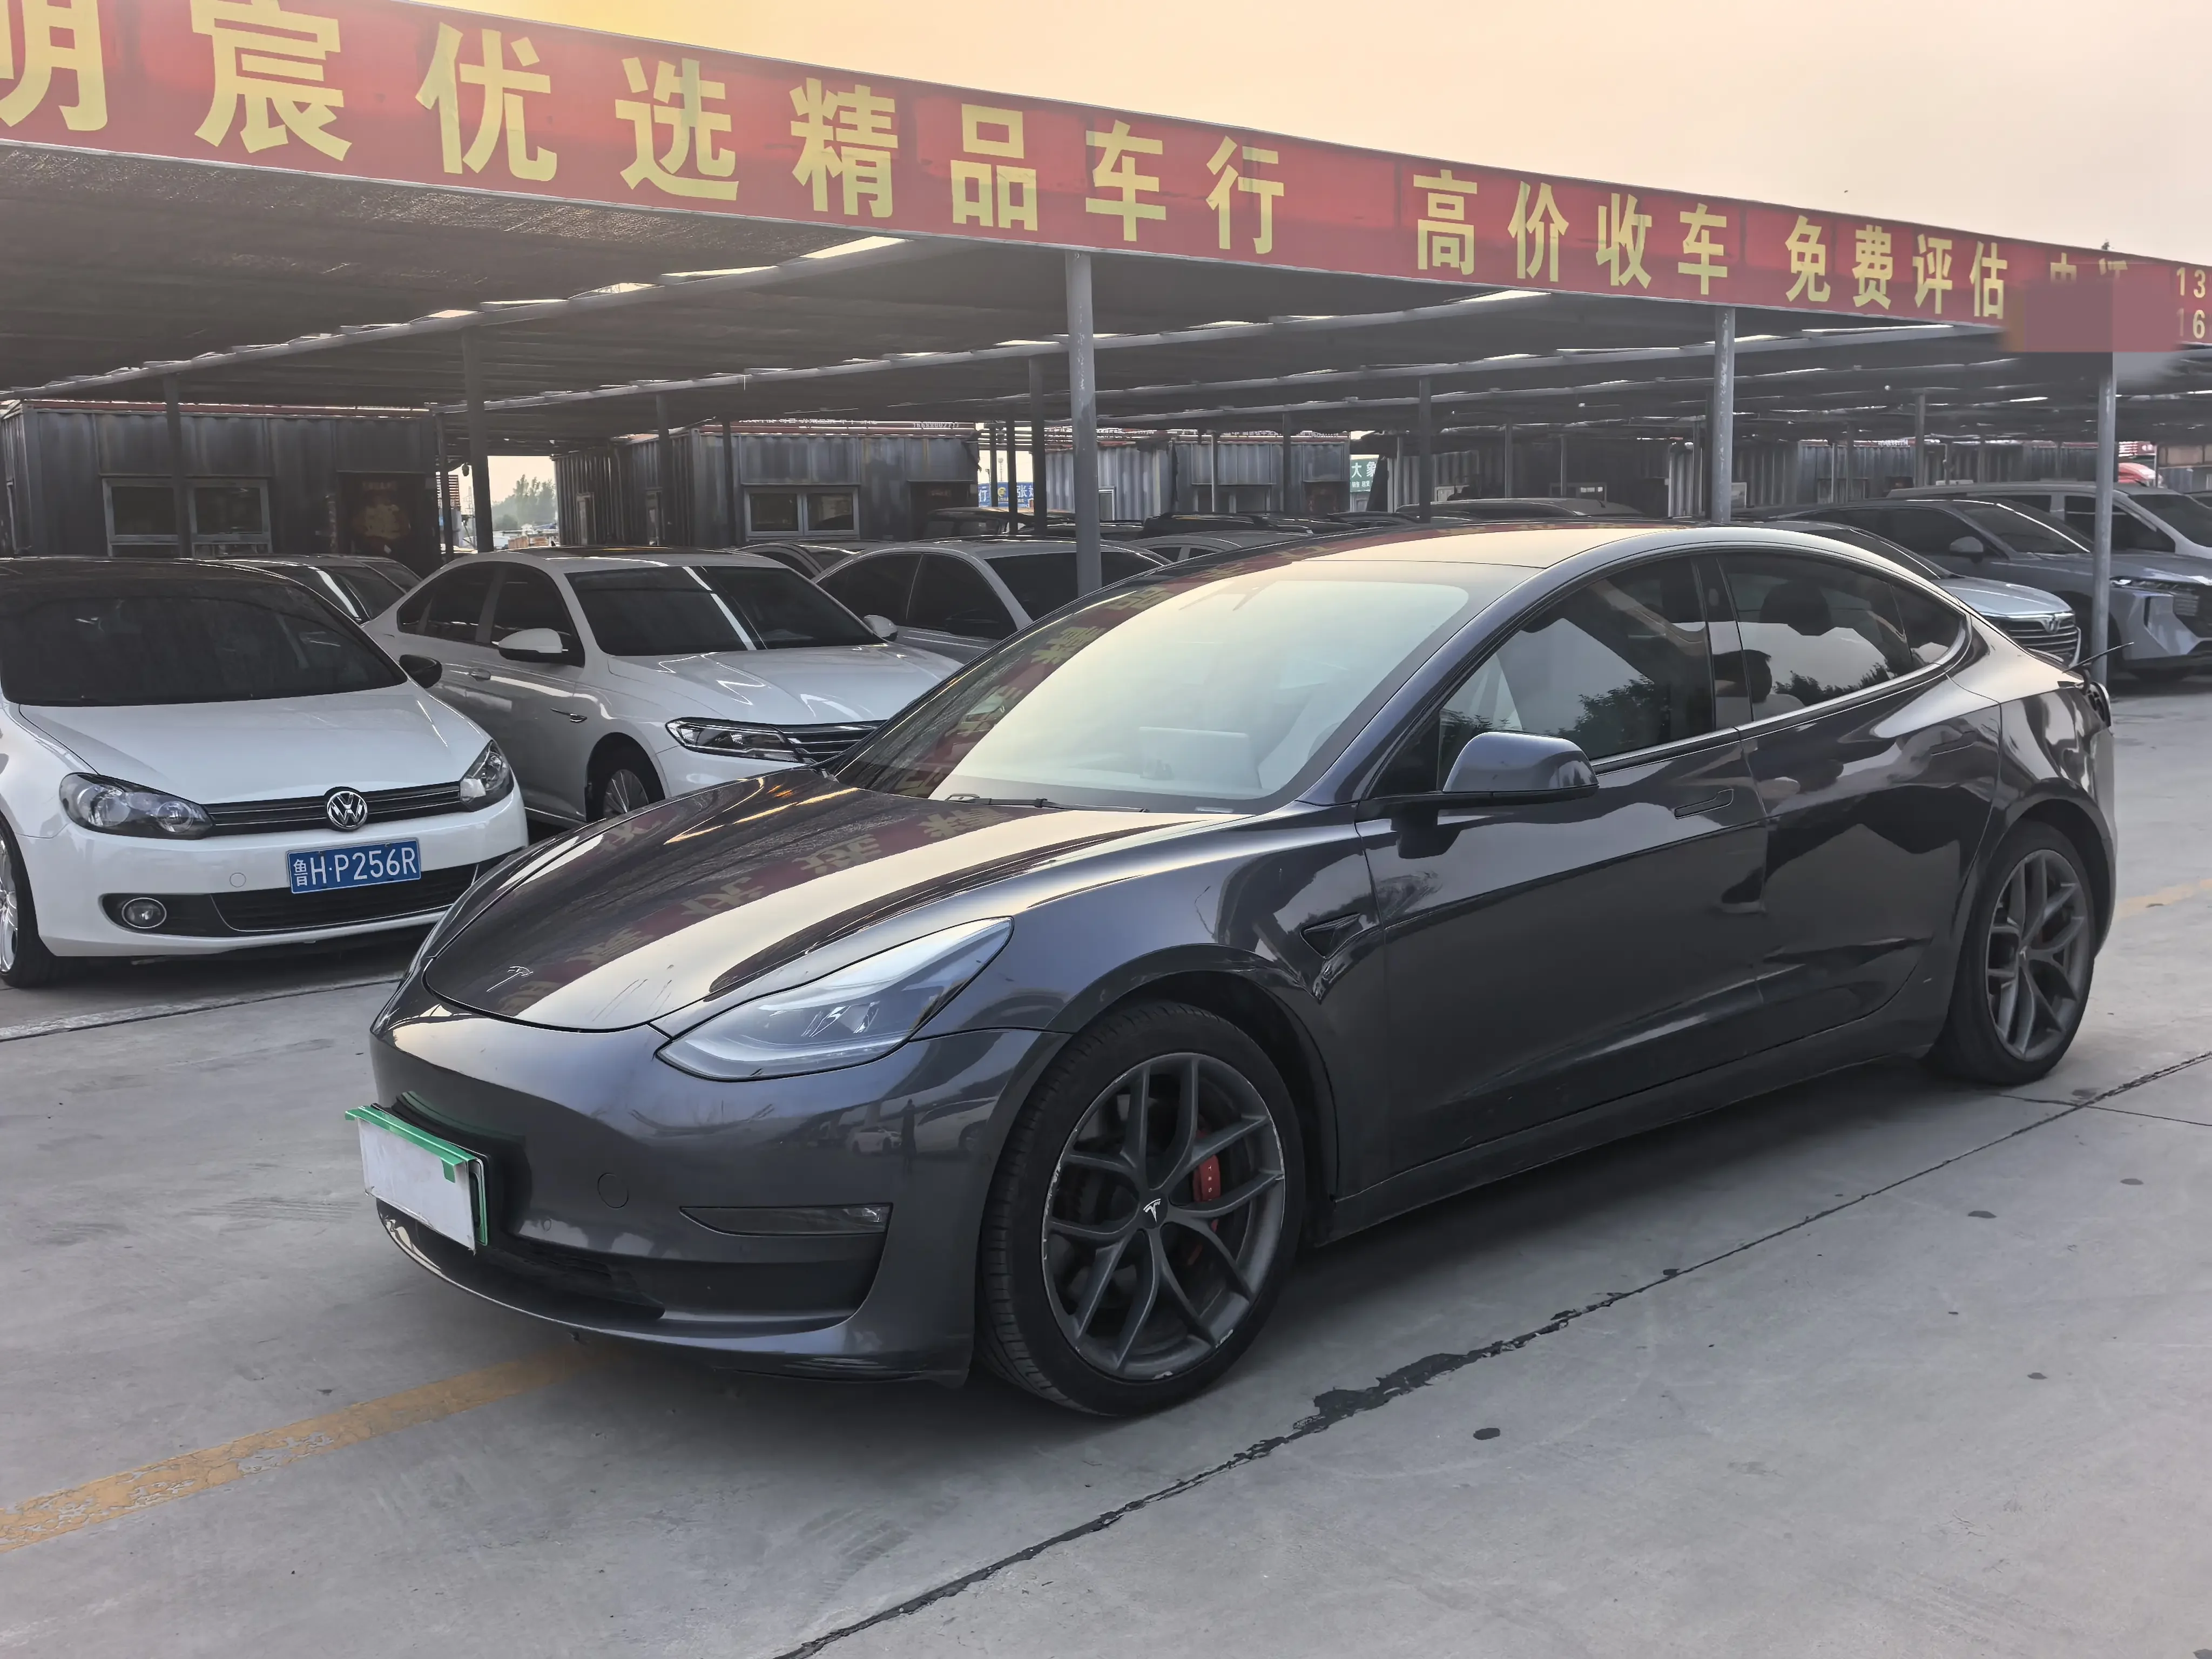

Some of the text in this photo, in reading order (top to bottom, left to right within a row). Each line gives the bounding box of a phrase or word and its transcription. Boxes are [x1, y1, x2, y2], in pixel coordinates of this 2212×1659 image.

[1413, 169, 1728, 295] 高价收车
[1785, 215, 2008, 320] 免费评估
[2176, 267, 2212, 298] 13
[2176, 308, 2212, 339] 16
